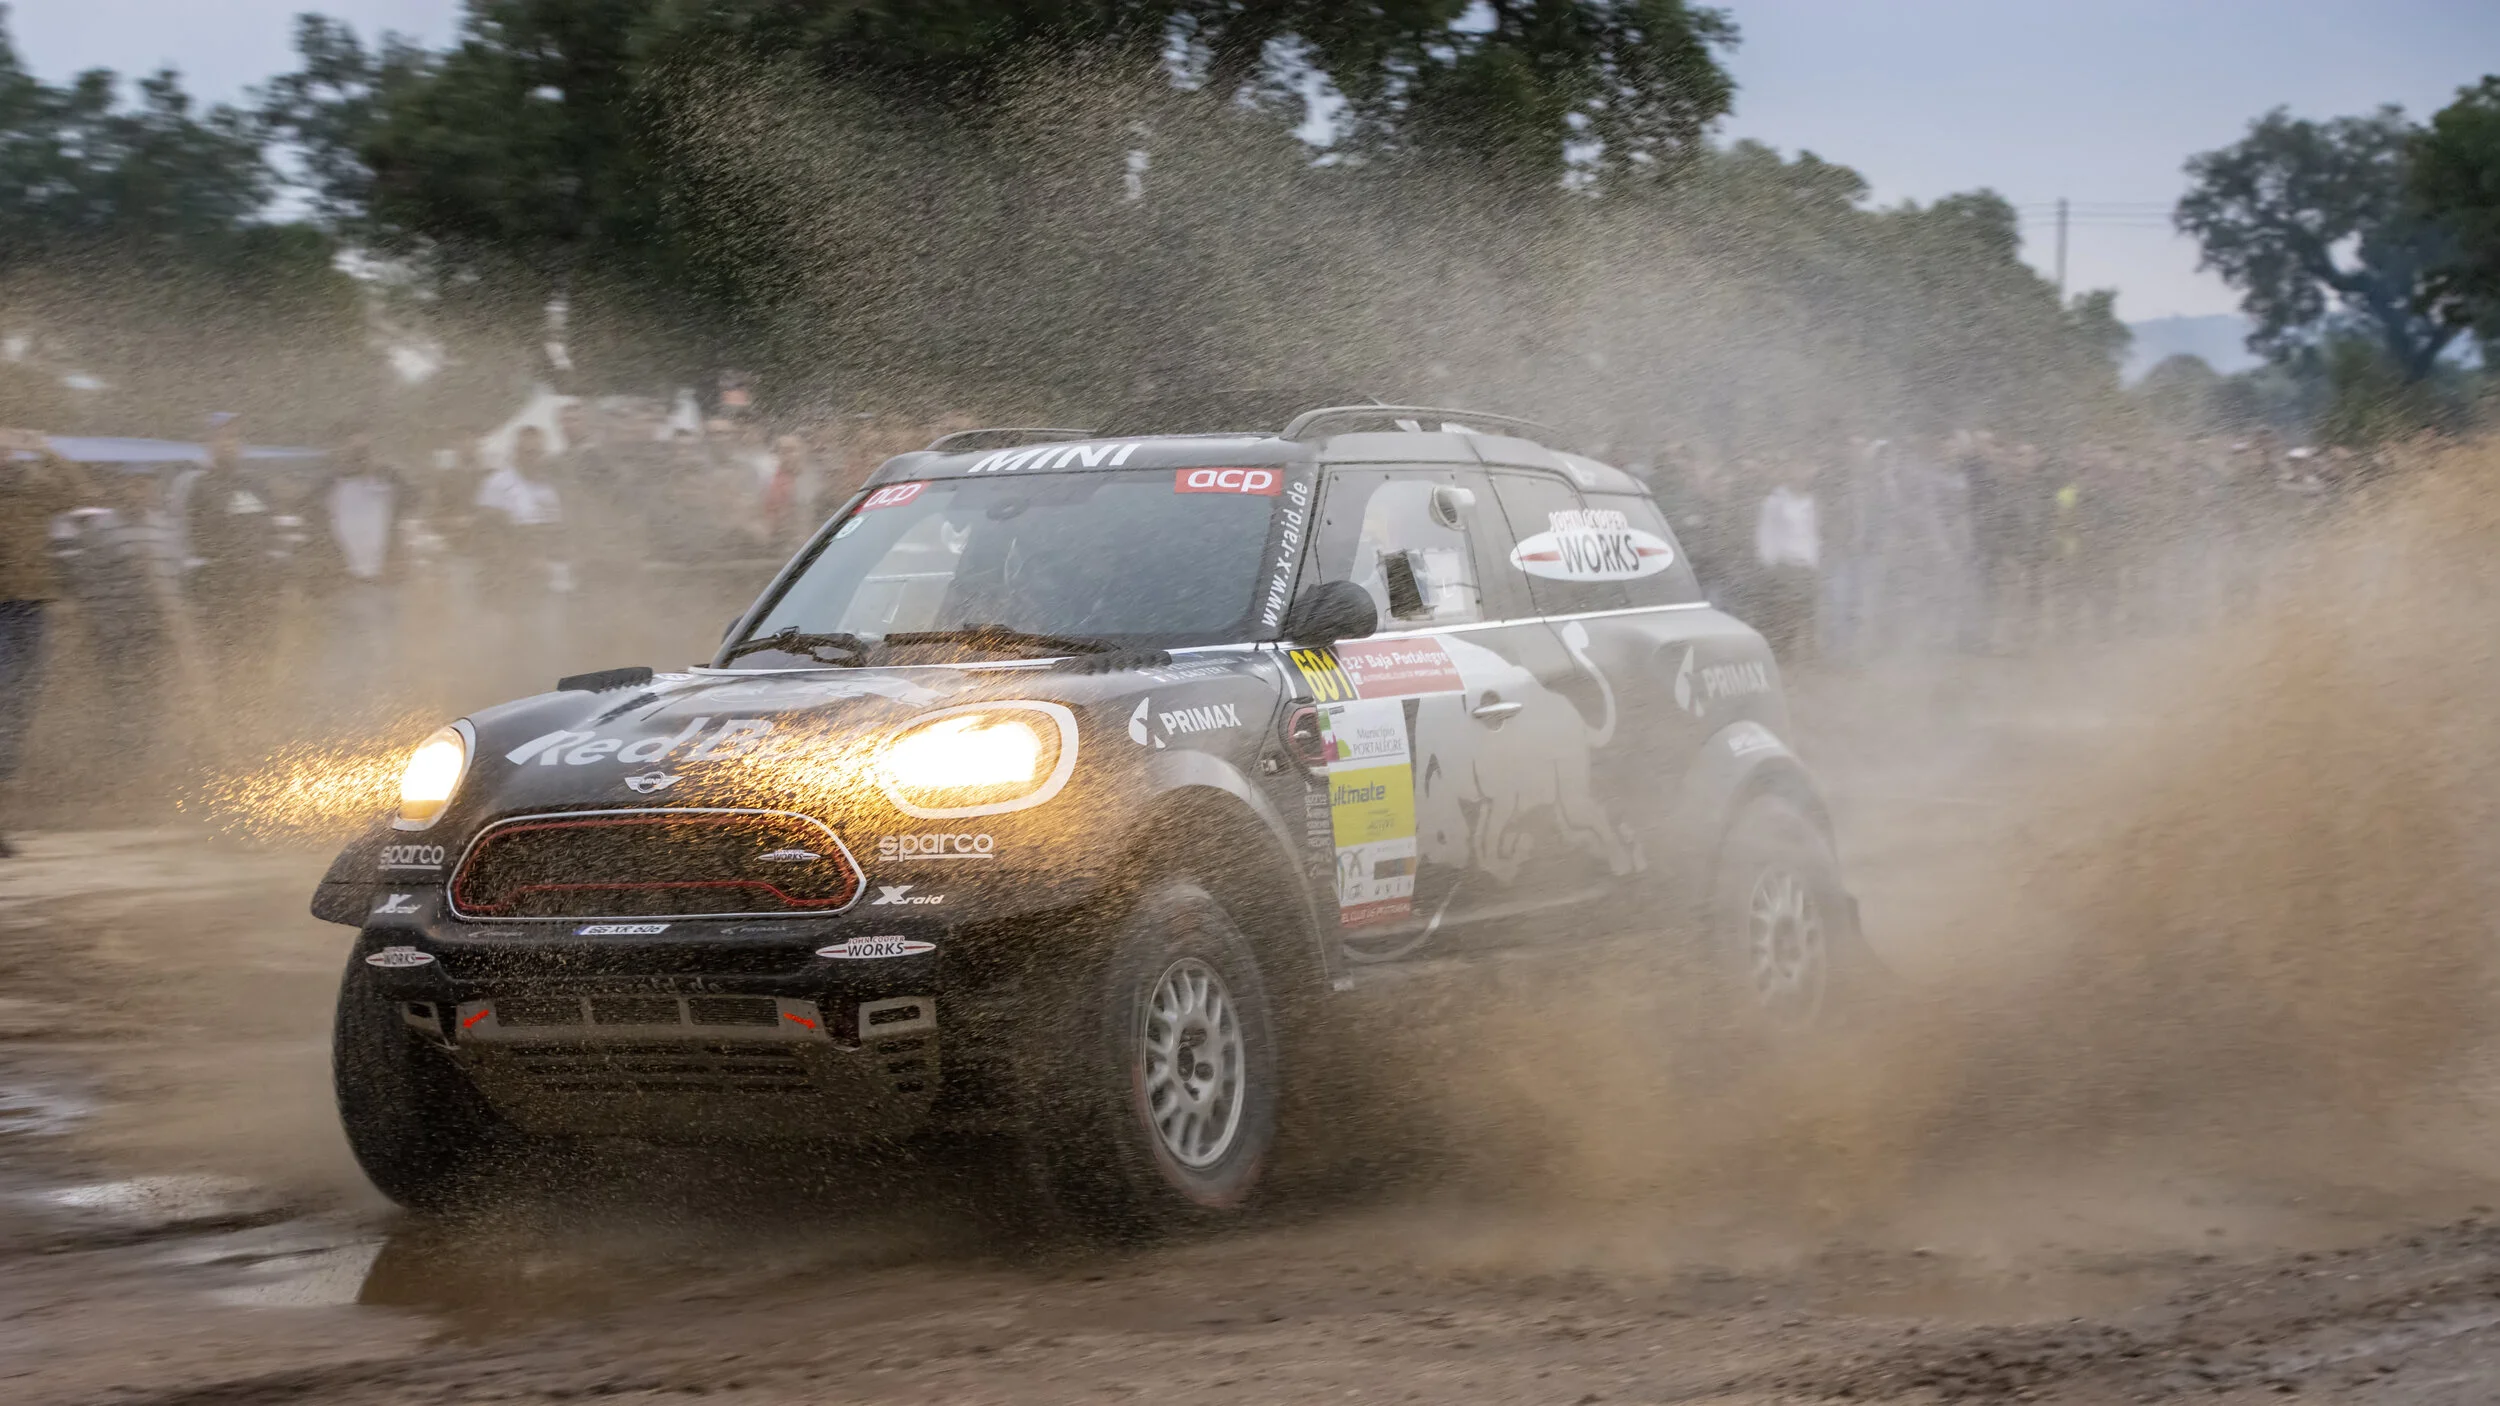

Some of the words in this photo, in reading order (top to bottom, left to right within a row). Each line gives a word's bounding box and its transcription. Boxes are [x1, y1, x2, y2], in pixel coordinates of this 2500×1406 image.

[968, 443, 1141, 473] MINI
[863, 483, 922, 508] acp
[1188, 470, 1273, 492] acp
[1262, 482, 1308, 628] www.x-raid.de
[1557, 534, 1640, 574] WORKS
[1365, 652, 1393, 670] Baja
[1391, 649, 1450, 666] Portalegre
[1290, 649, 1353, 702] 601
[1702, 661, 1771, 698] PRIMAX
[1159, 703, 1241, 735] PRIMAX
[505, 717, 711, 766] Red
[379, 844, 445, 870] sparco
[878, 833, 993, 862] sparco
[847, 942, 904, 957] WORKS
[848, 936, 871, 944] JOHN
[871, 935, 905, 943] COOPER
